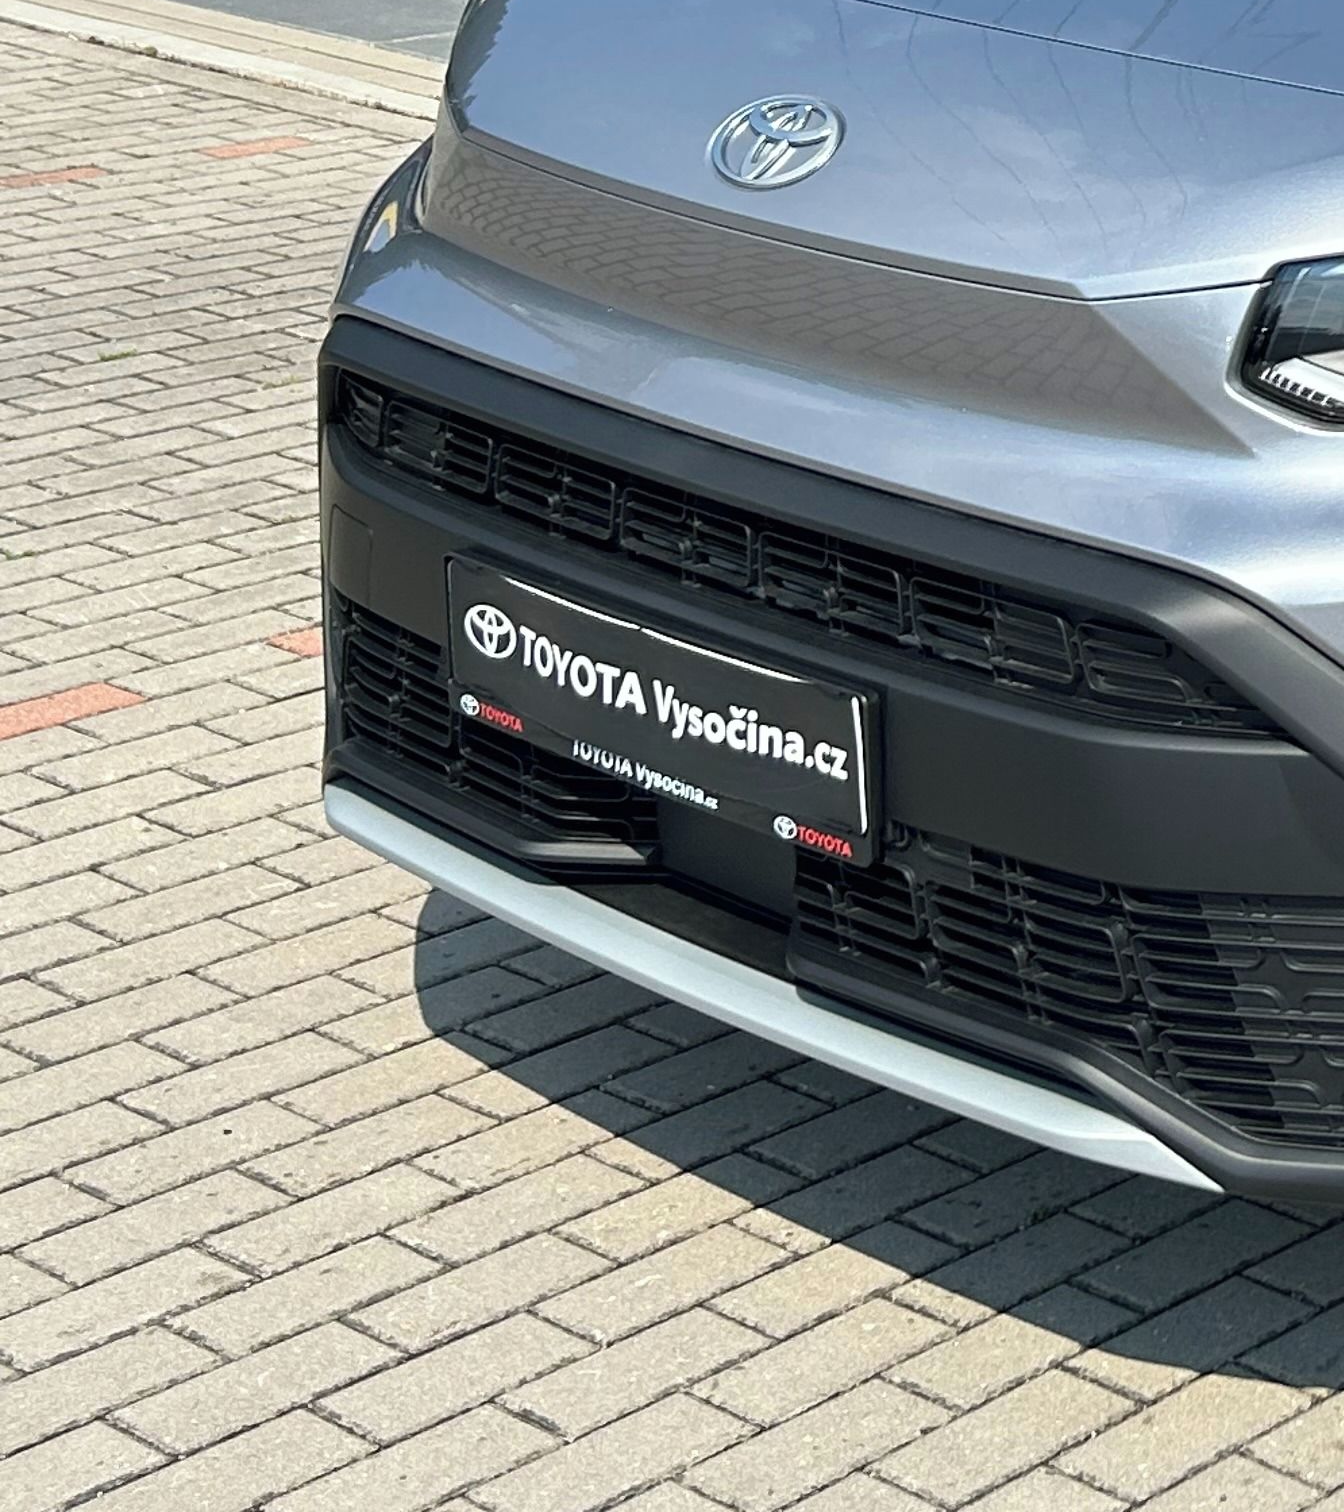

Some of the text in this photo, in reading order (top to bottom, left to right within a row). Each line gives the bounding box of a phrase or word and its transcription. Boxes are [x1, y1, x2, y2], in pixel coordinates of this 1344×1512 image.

[478, 701, 525, 734] TOYOTA
[519, 625, 849, 781] TOYOTA Vysočina.cz
[573, 739, 634, 778] TOYOTA
[798, 825, 854, 860] TOYOTA
